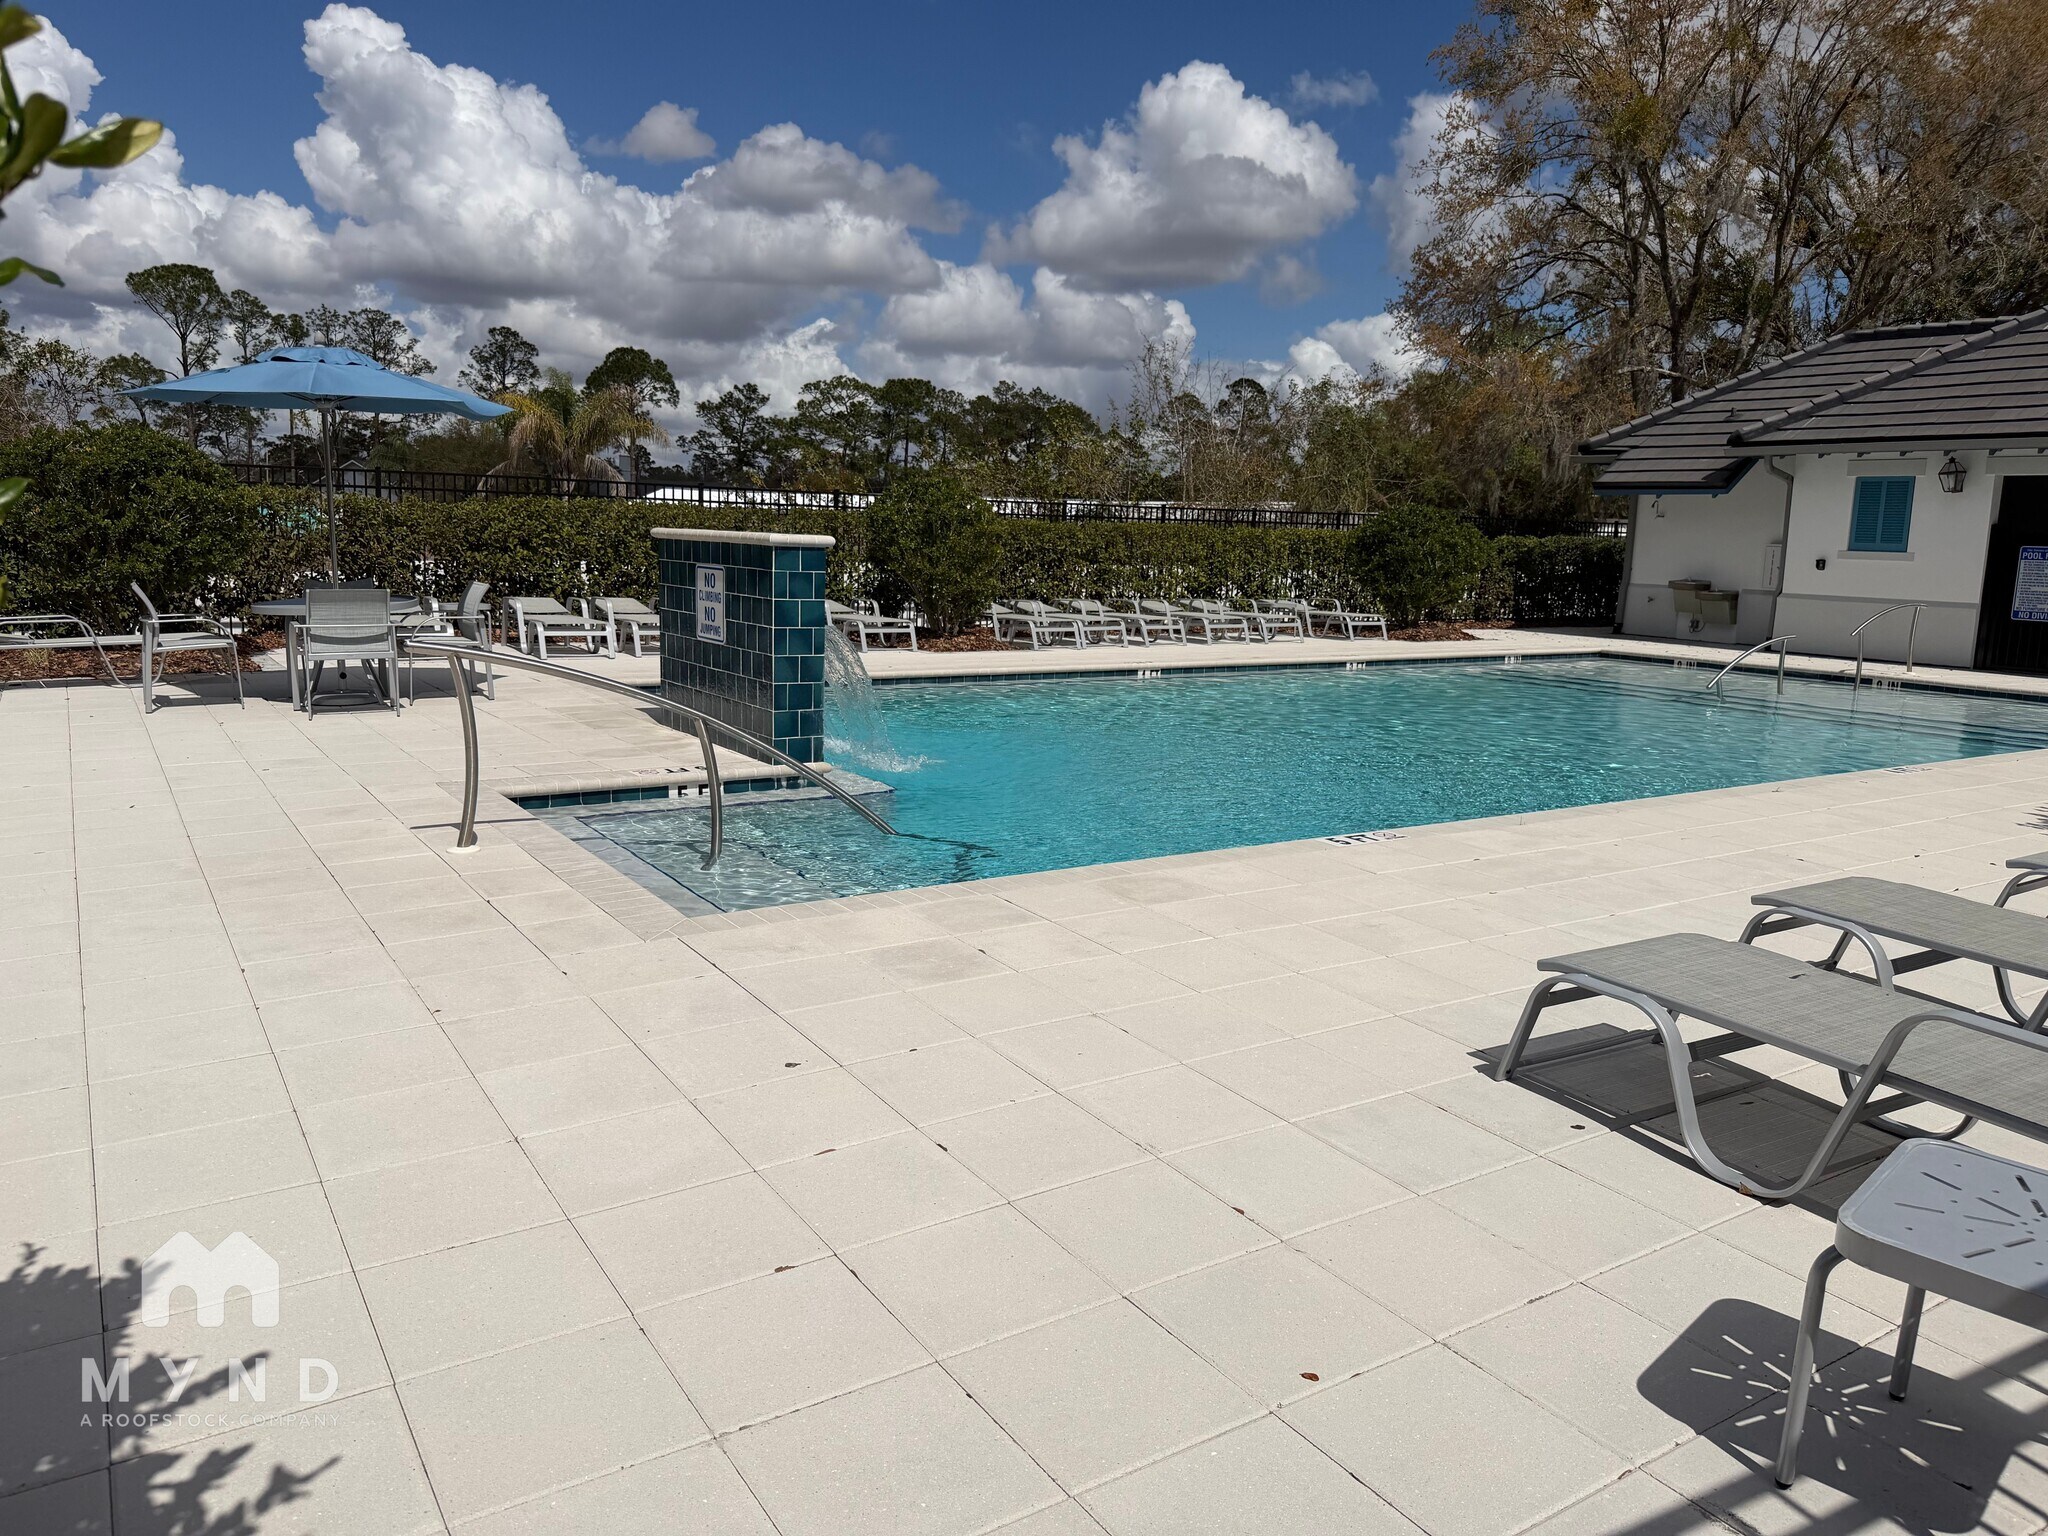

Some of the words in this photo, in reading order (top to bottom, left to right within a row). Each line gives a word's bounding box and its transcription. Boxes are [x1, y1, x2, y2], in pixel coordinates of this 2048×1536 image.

[704, 572, 715, 588] NO
[699, 590, 721, 603] CLIMBING
[704, 606, 715, 622] NO
[2018, 611, 2030, 619] NO
[700, 623, 721, 637] JUMPING
